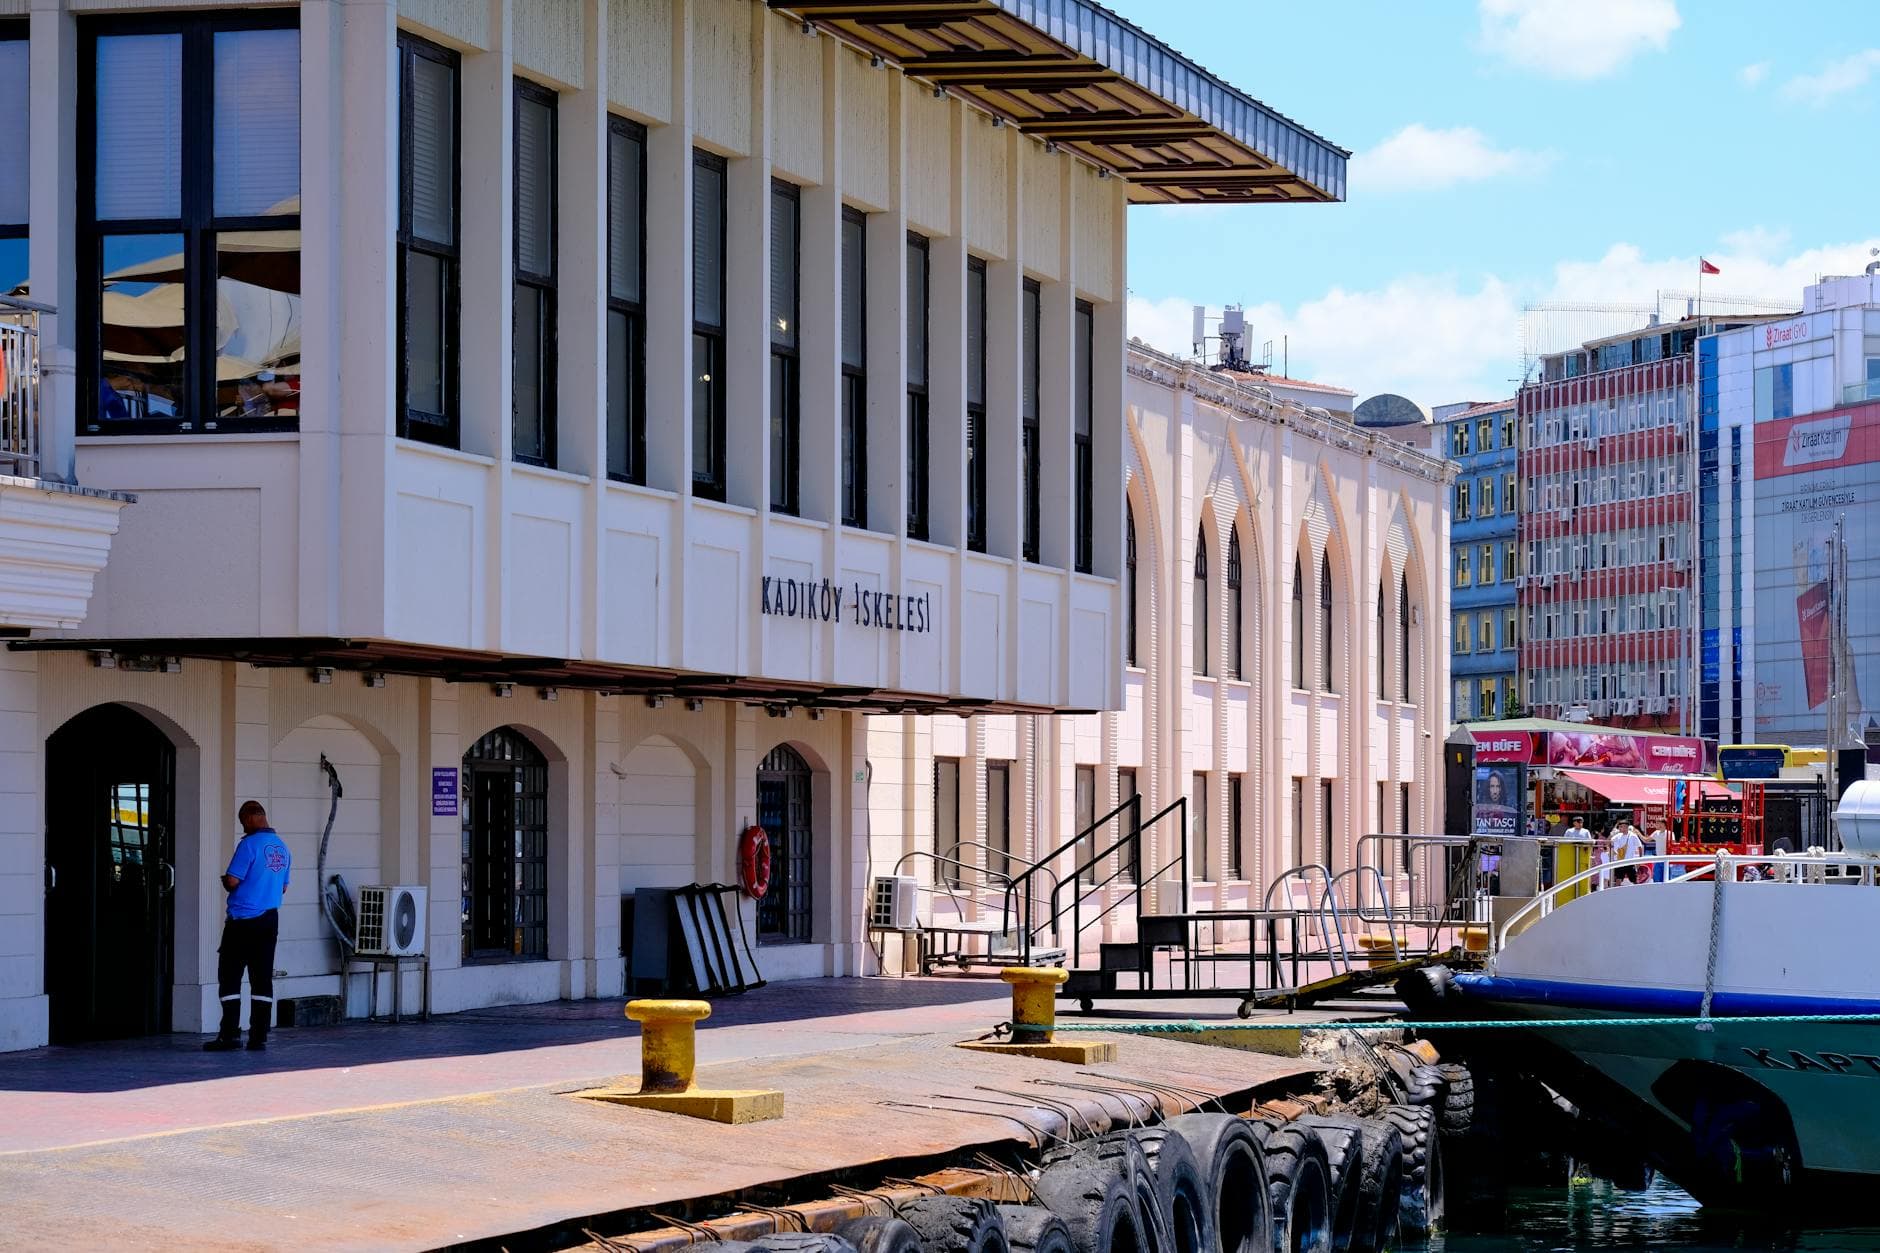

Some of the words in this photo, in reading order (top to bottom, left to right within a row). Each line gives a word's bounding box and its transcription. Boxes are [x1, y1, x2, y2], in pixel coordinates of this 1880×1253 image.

[762, 576, 843, 623] KADIKÖY
[1475, 741, 1491, 752] EM
[1493, 739, 1522, 752] BÜFE
[1476, 817, 1491, 827] TAN
